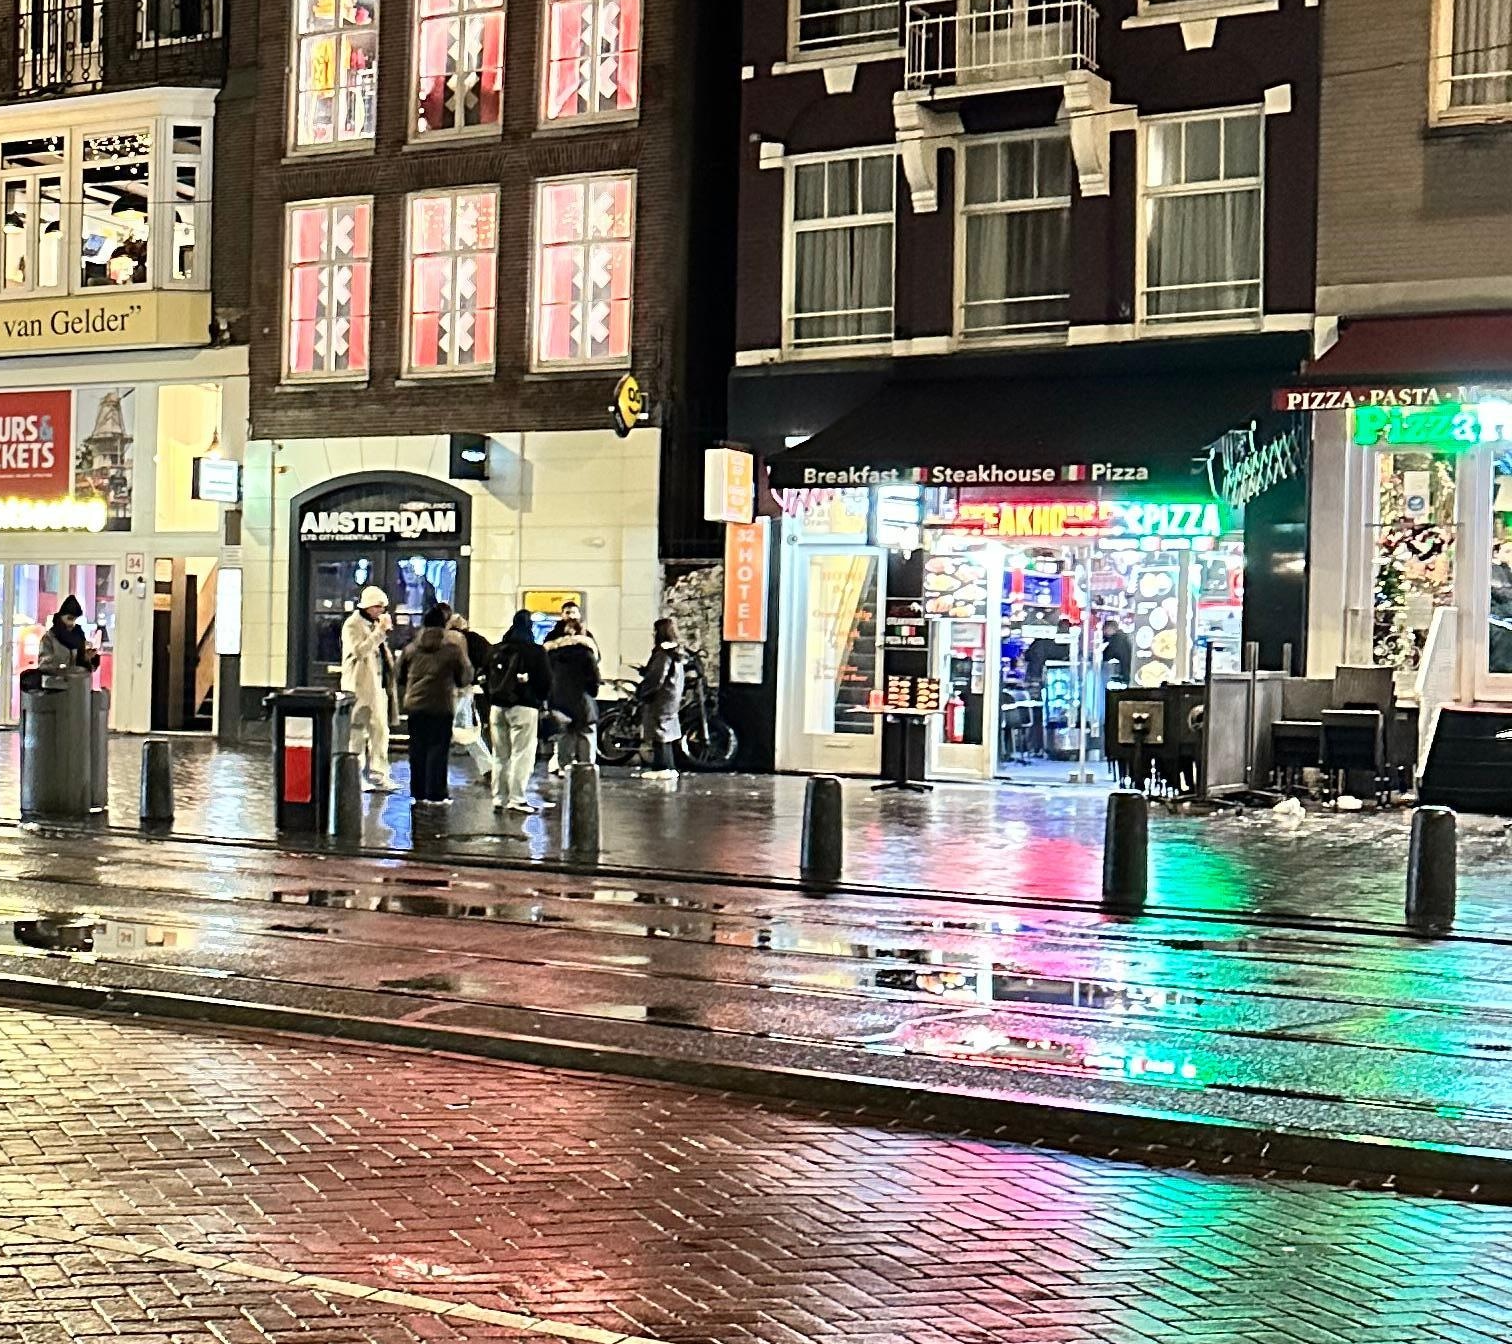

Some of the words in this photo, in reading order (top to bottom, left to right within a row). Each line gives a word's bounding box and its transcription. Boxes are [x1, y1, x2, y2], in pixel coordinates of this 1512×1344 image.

[3, 318, 43, 338] van
[1286, 391, 1355, 411] PIZZA
[1369, 387, 1441, 407] PASTA
[803, 465, 900, 484] Breakfast
[931, 464, 1056, 483] Steakhouse
[1091, 463, 1149, 481] Pizza
[300, 510, 456, 534] AMSTERDAM
[738, 529, 756, 543] 32
[737, 548, 754, 638] HOTEL
